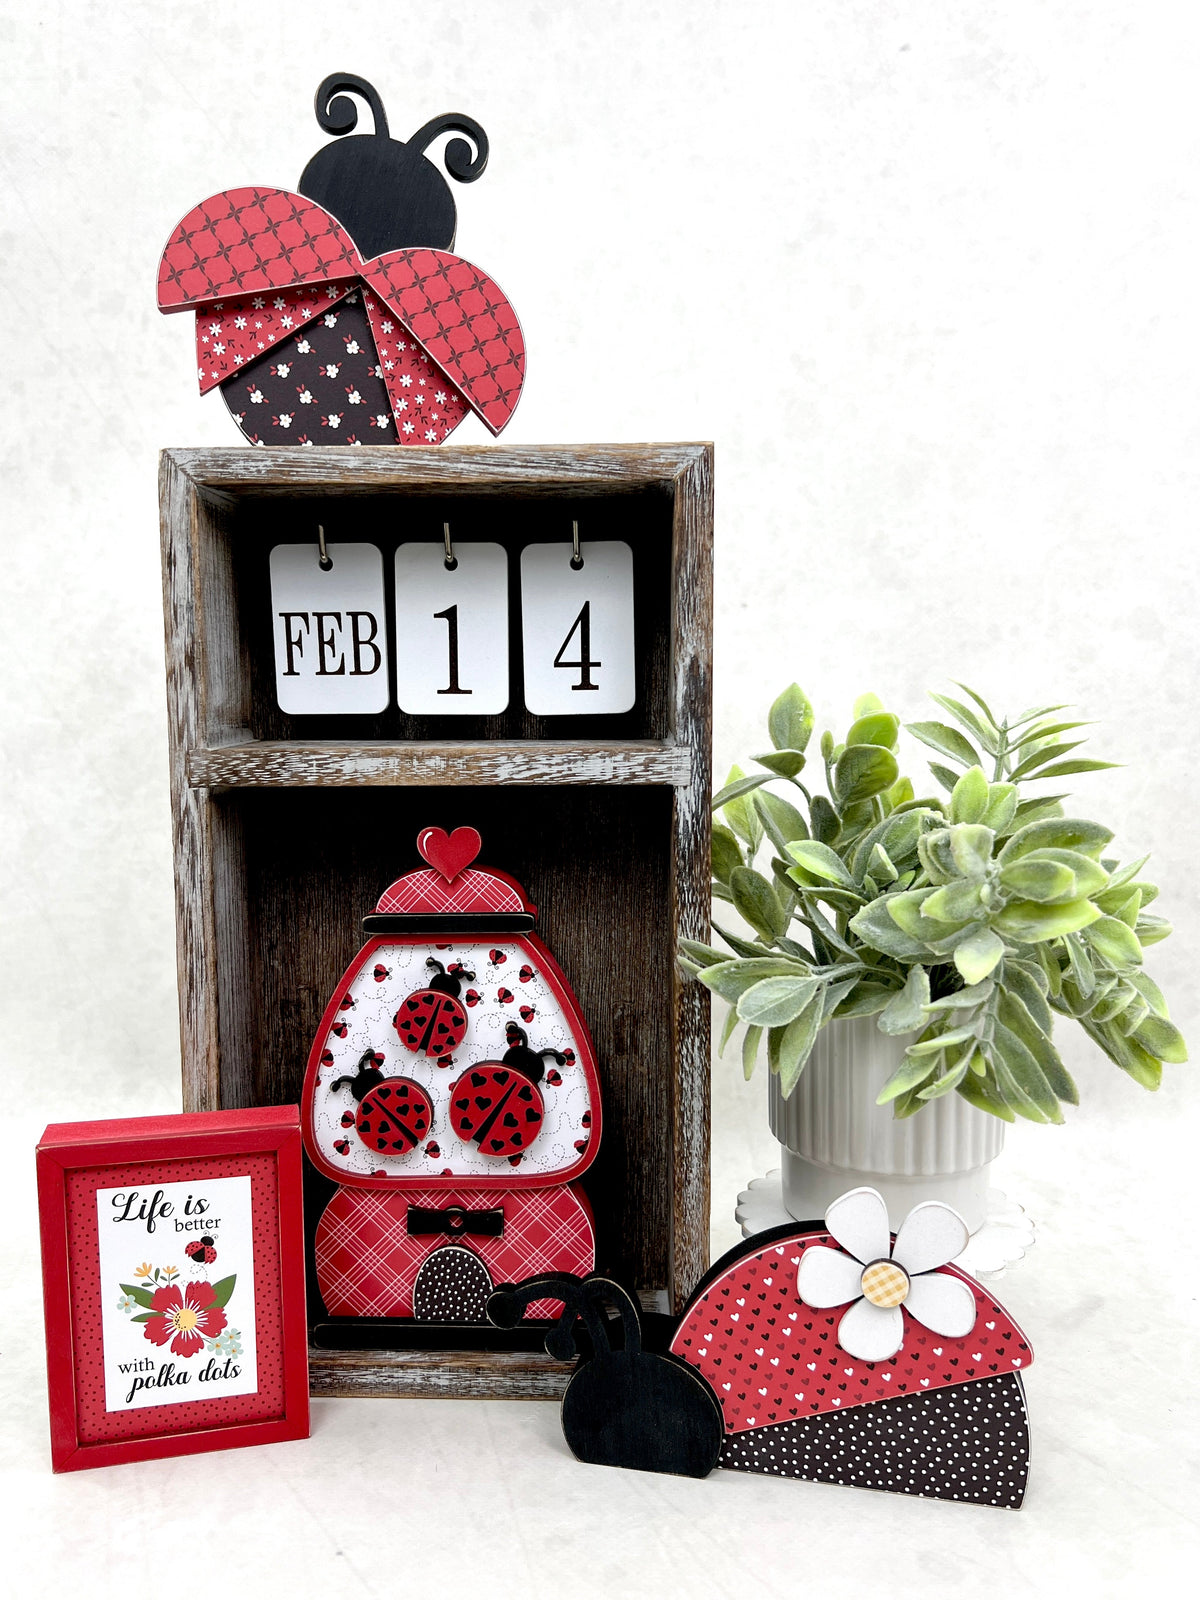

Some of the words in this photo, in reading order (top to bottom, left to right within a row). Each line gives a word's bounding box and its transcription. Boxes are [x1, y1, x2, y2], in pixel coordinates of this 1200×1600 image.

[279, 611, 382, 676] FEB
[111, 1190, 175, 1233] Life
[184, 1194, 210, 1216] is
[174, 1217, 221, 1233] better
[117, 1357, 155, 1374] with
[125, 1363, 192, 1404] polka
[198, 1357, 242, 1383] dots
